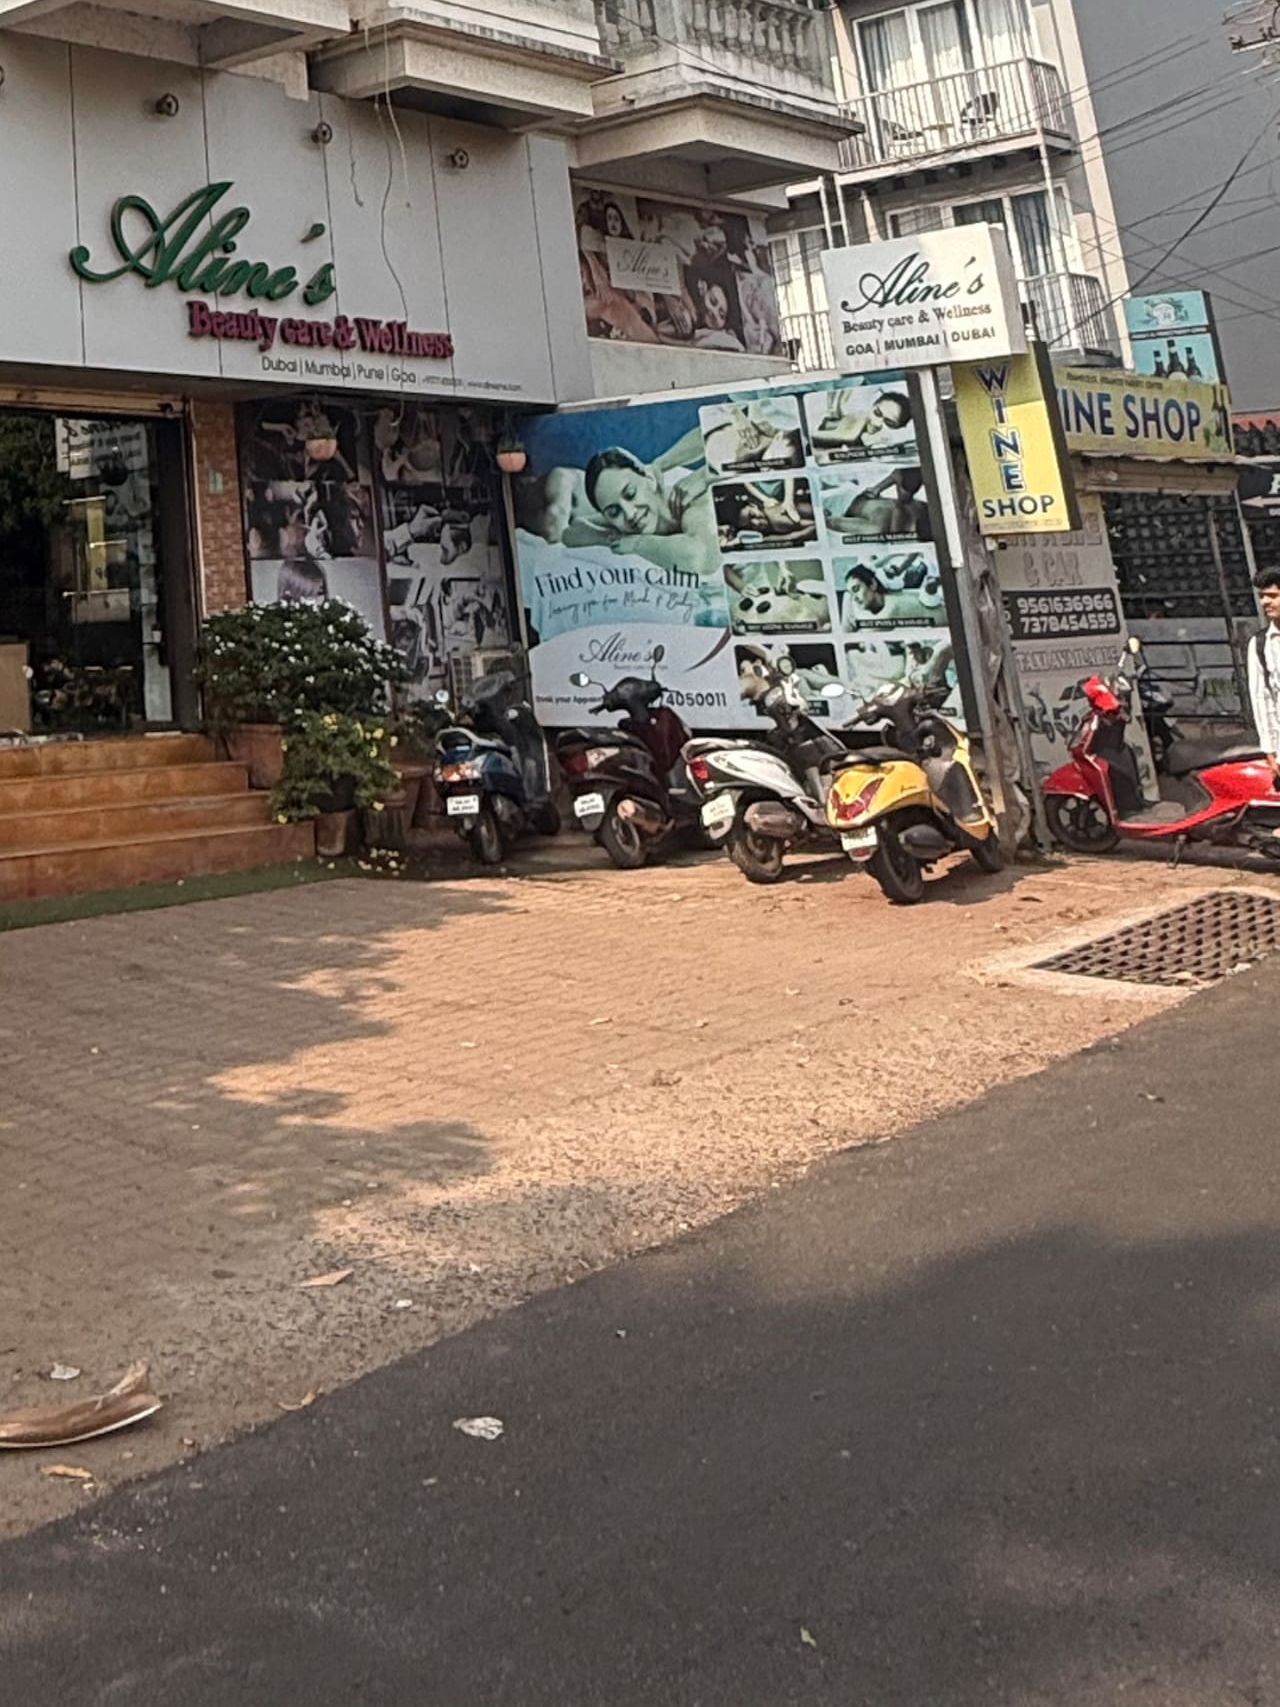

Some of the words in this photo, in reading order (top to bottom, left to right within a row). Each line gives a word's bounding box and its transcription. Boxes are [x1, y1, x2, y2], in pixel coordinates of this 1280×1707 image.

[69, 180, 337, 306] Aline's
[840, 251, 985, 313] Aline's
[187, 300, 279, 352] Beauty
[280, 317, 333, 348] care
[333, 315, 357, 351] &
[354, 317, 455, 359] Wellness
[842, 318, 884, 334] Beauty
[888, 314, 914, 328] care
[918, 309, 930, 323] &
[932, 303, 992, 321] Wellness
[845, 343, 875, 356] GOA
[884, 333, 940, 351] MUMBAI
[951, 326, 996, 343] DUBAI
[262, 356, 298, 373] Dubai
[305, 361, 352, 377] Mumbai
[357, 365, 385, 380] Pune
[391, 368, 417, 383] Goa
[975, 364, 1025, 492] WINE
[1057, 386, 1116, 436] INE
[1123, 393, 1201, 442] SHOP
[982, 494, 1055, 518] SHOP
[535, 566, 583, 597] Find
[586, 566, 639, 593] your
[661, 691, 727, 707] 4050011
